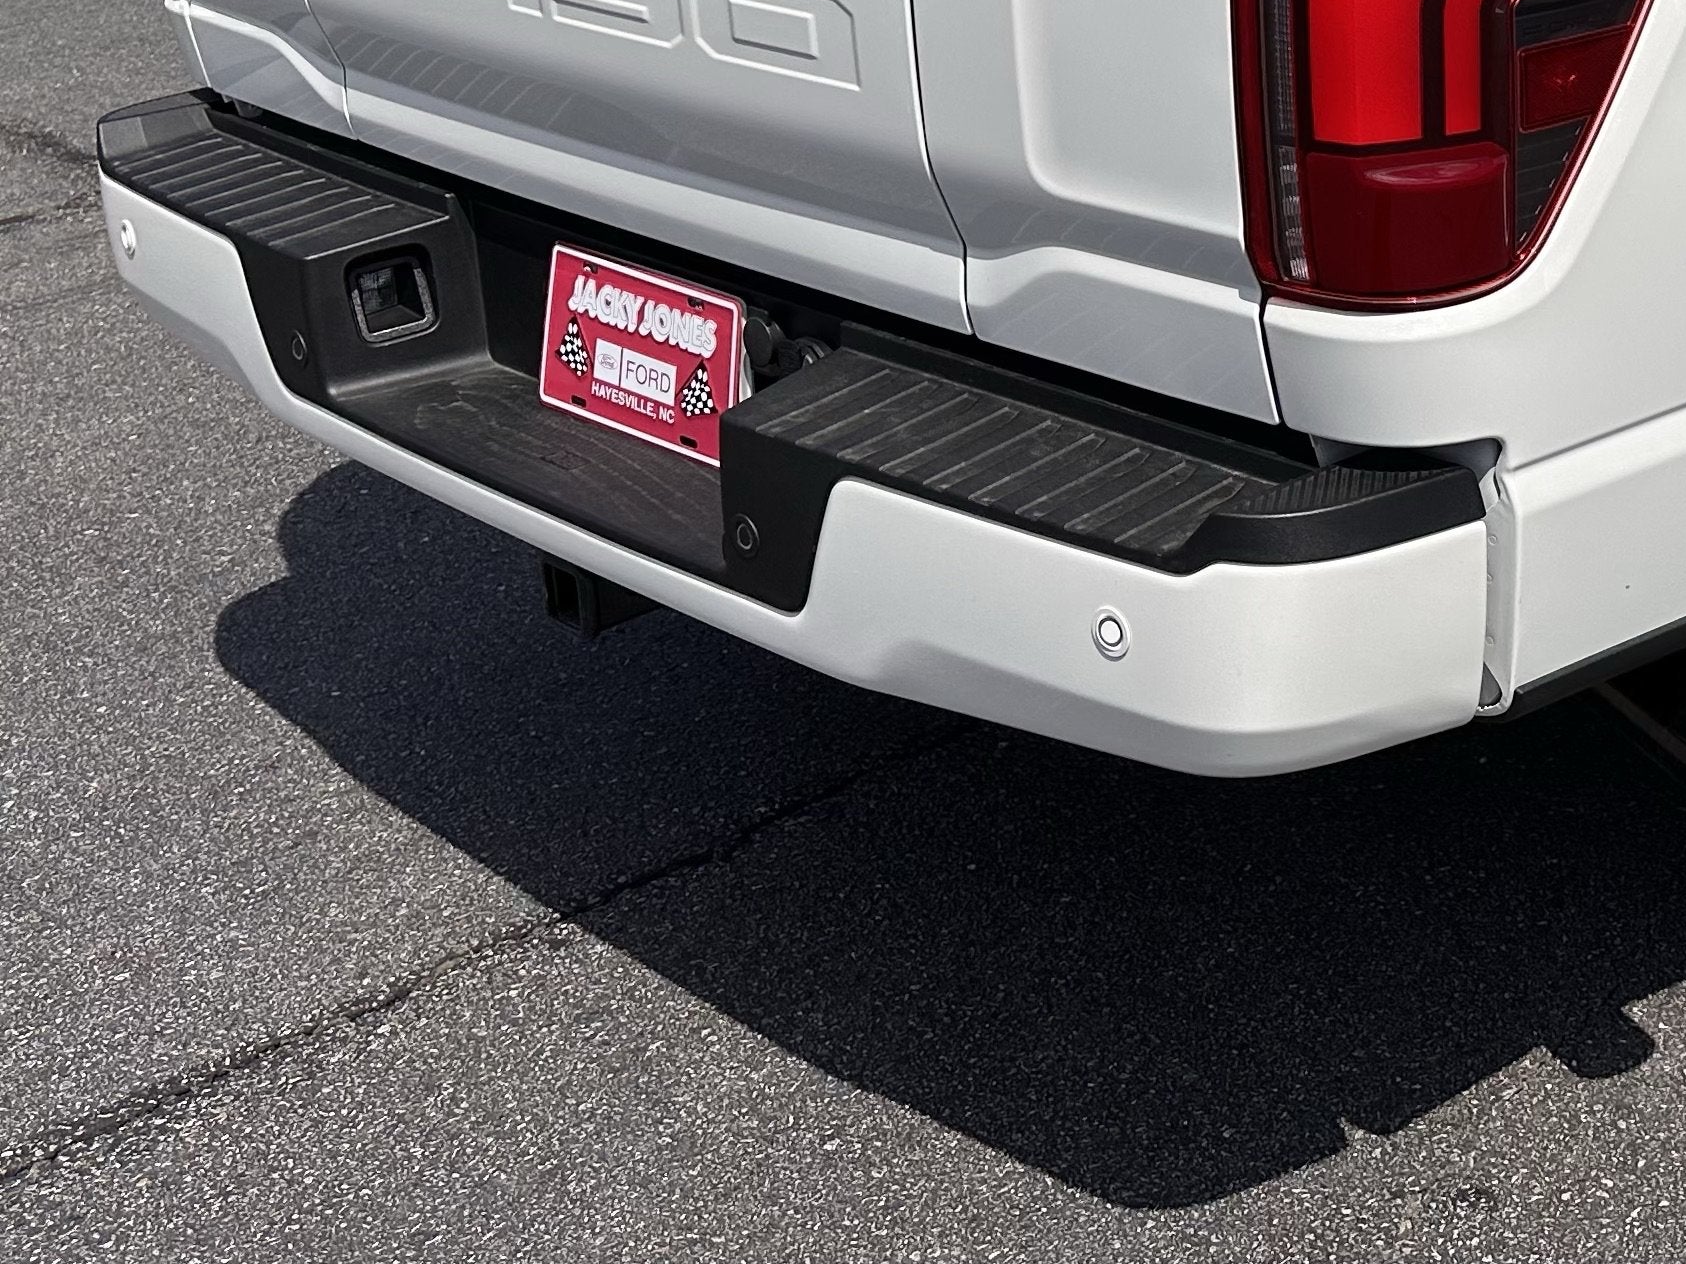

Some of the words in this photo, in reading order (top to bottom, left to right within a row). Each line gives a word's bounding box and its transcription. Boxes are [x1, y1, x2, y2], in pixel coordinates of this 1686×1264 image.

[568, 274, 645, 336] JACKY
[638, 299, 718, 359] JONES
[626, 360, 671, 394] FORD
[592, 381, 657, 420] HAYESVILLE,
[658, 406, 675, 424] NC
